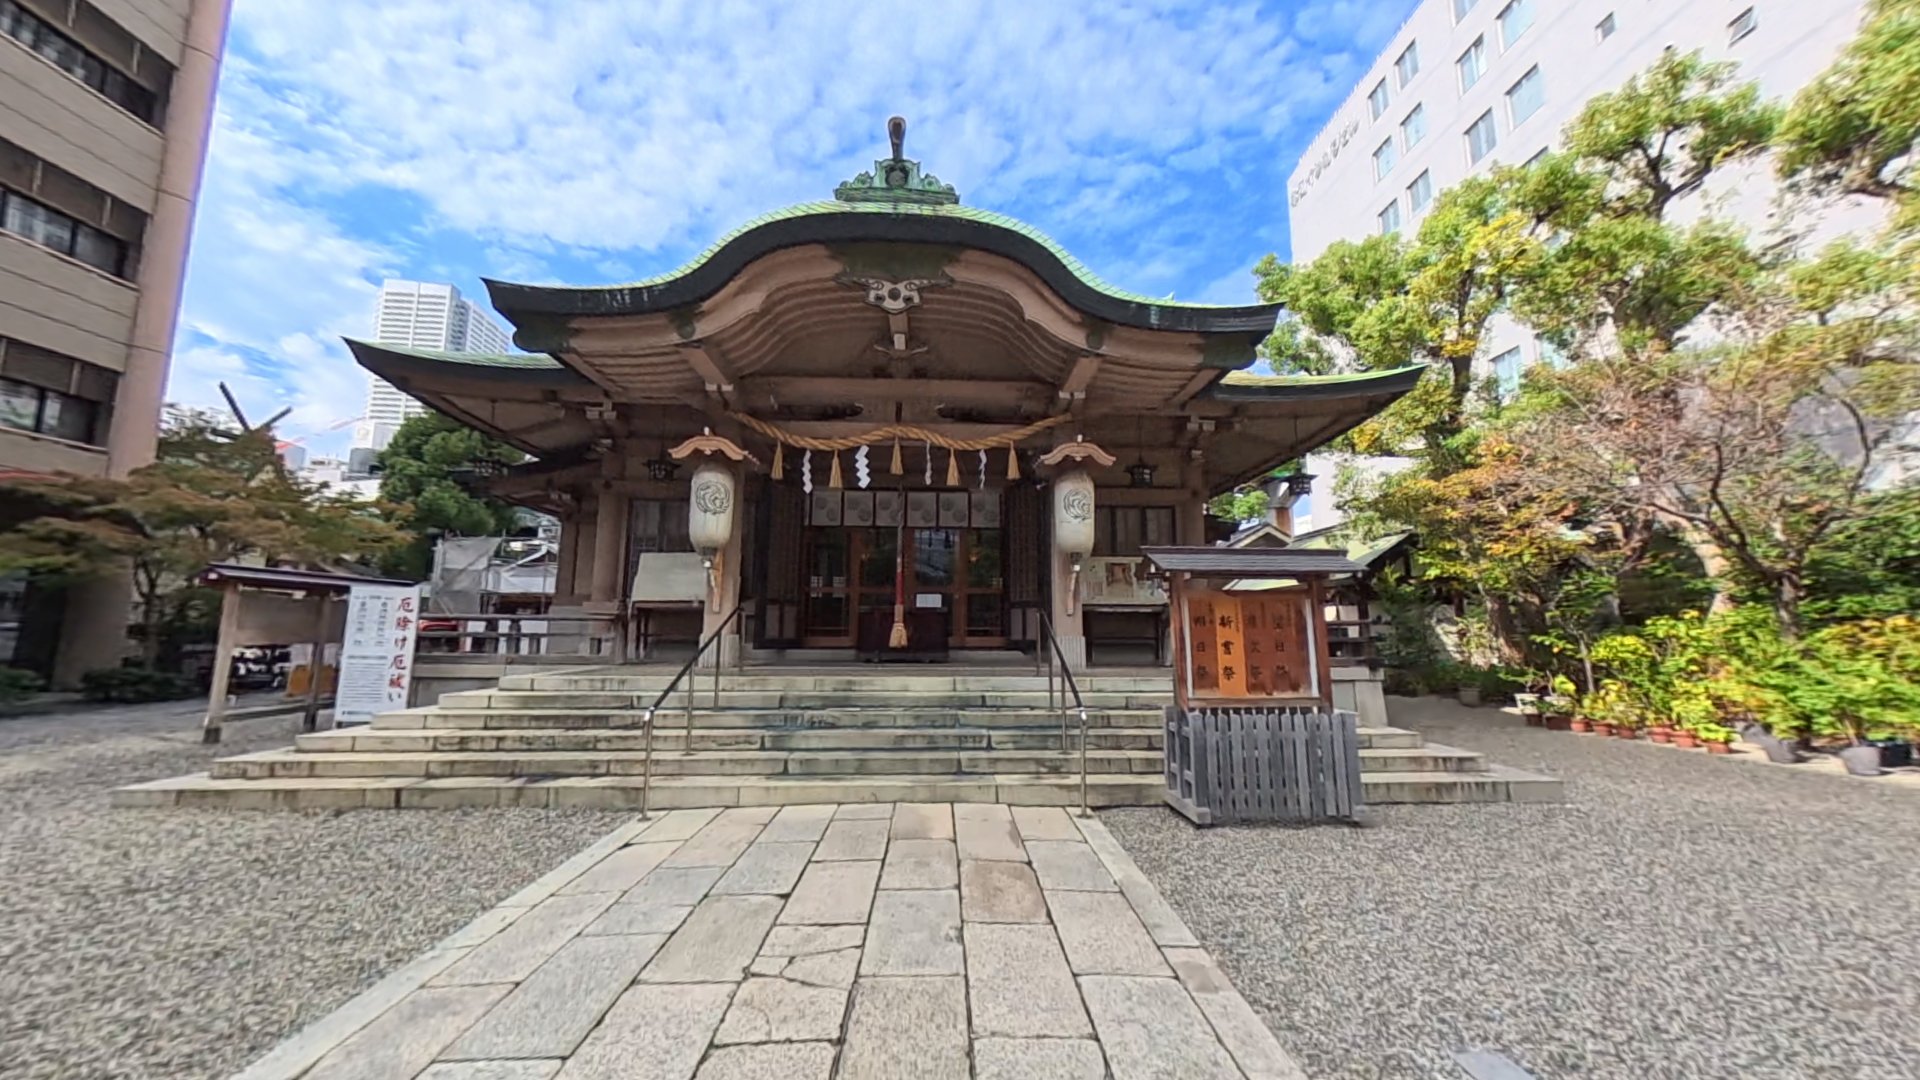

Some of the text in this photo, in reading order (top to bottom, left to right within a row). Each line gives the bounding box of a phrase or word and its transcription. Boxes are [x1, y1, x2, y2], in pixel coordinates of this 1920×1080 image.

[388, 596, 414, 703] 厄除け厄祓い
[1219, 615, 1236, 681] 新嘗祭
